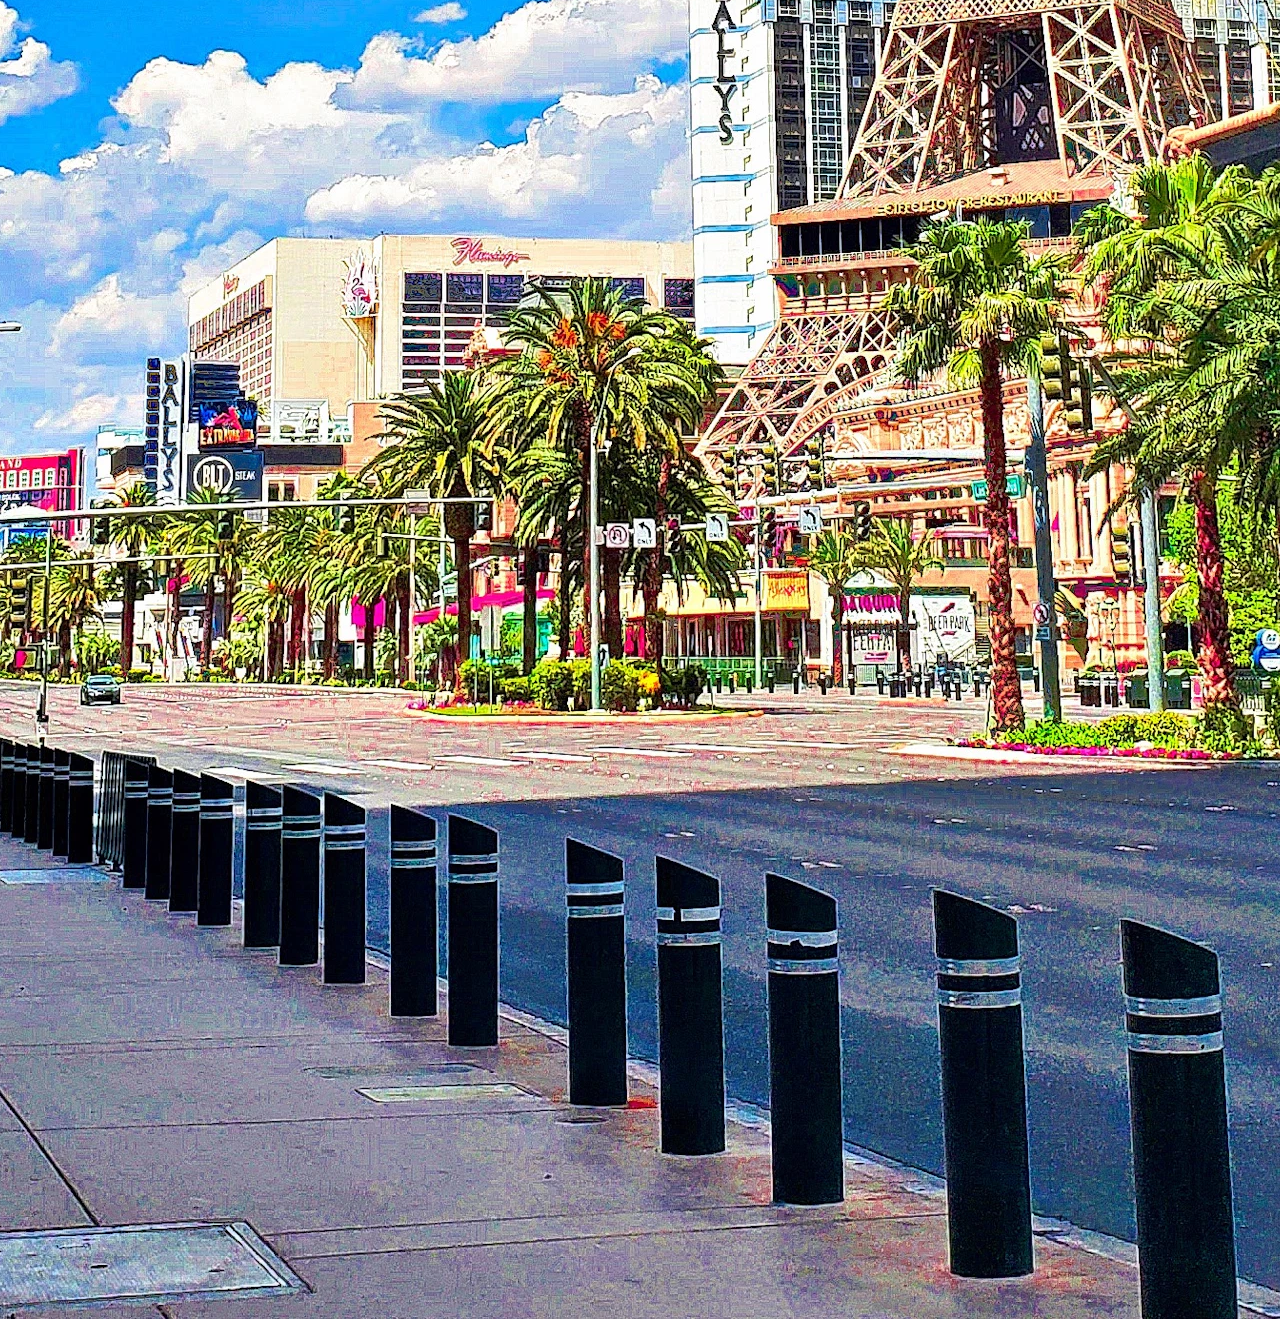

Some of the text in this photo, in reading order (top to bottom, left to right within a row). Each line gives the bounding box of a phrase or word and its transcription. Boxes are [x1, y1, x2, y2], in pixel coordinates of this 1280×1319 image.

[929, 197, 973, 211] TOWER
[981, 189, 1059, 207] RESTAURANT
[450, 237, 531, 269] Flamingo
[161, 363, 179, 492] BALLYS
[203, 464, 256, 488] BLT STEAK
